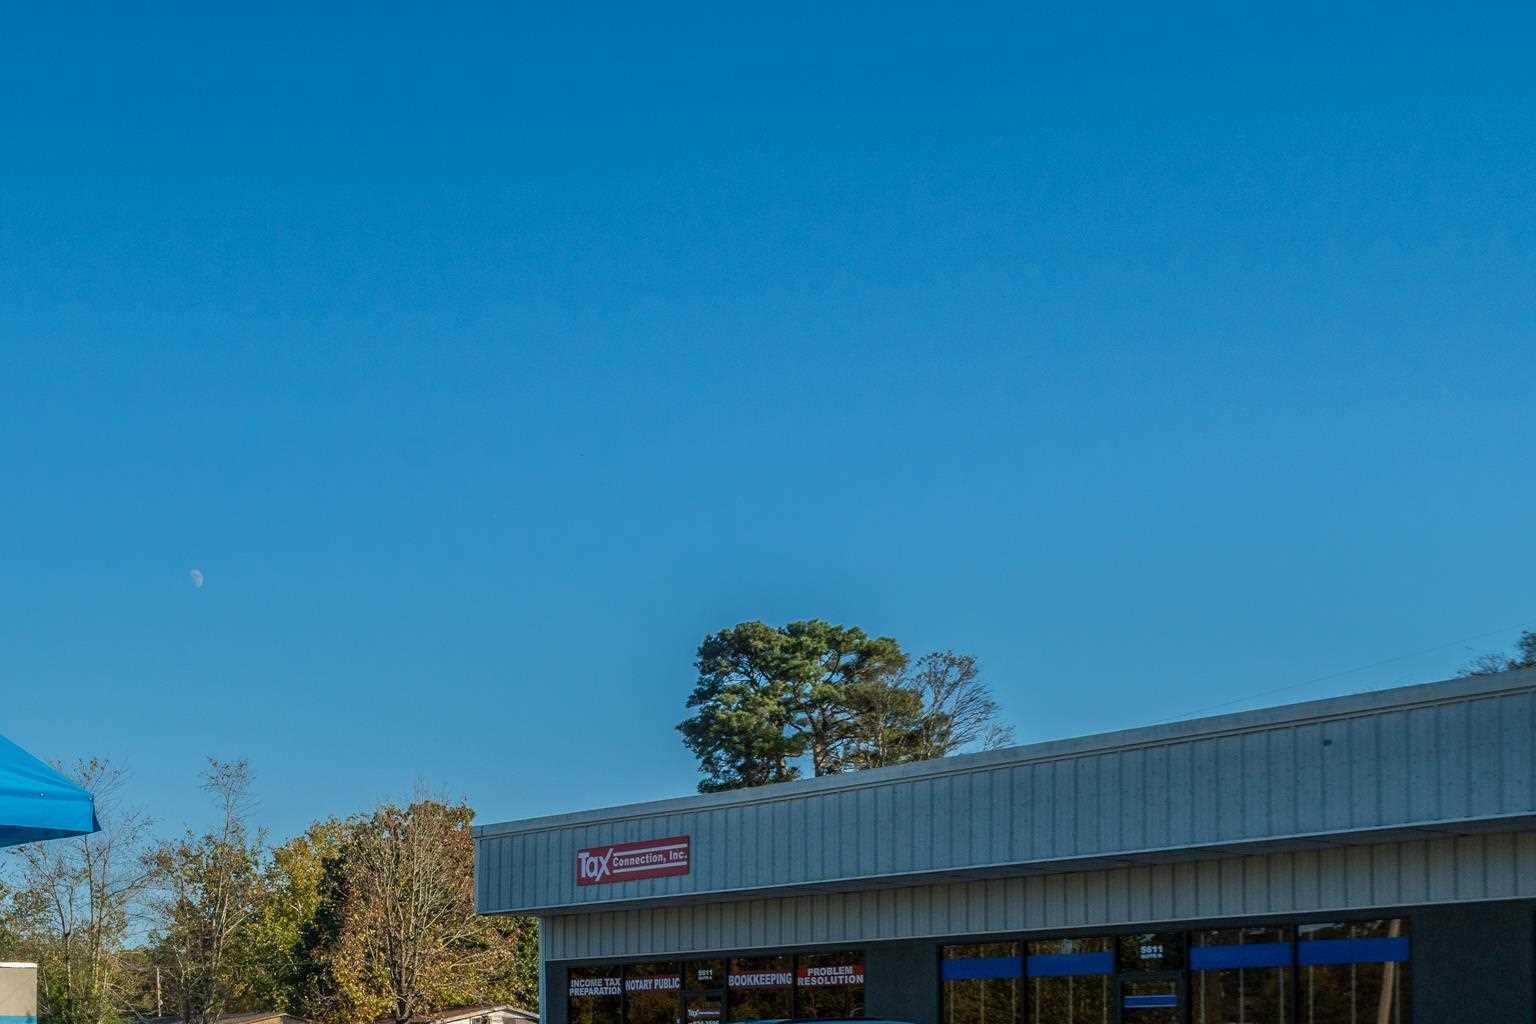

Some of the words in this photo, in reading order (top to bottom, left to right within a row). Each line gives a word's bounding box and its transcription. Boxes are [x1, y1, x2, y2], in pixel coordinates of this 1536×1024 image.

[578, 847, 614, 881] Tax
[612, 853, 666, 867] Connection,
[669, 850, 689, 861] Inc.
[807, 966, 853, 976] PROBLEM
[570, 978, 603, 988] INCOME
[604, 977, 622, 987] TAX
[625, 979, 653, 991] NOTARY
[654, 978, 681, 989] PUBLIC
[728, 973, 792, 986] BOOKKEEPING
[798, 975, 864, 986] RESOLUTION
[569, 986, 622, 996] PREPARATION
